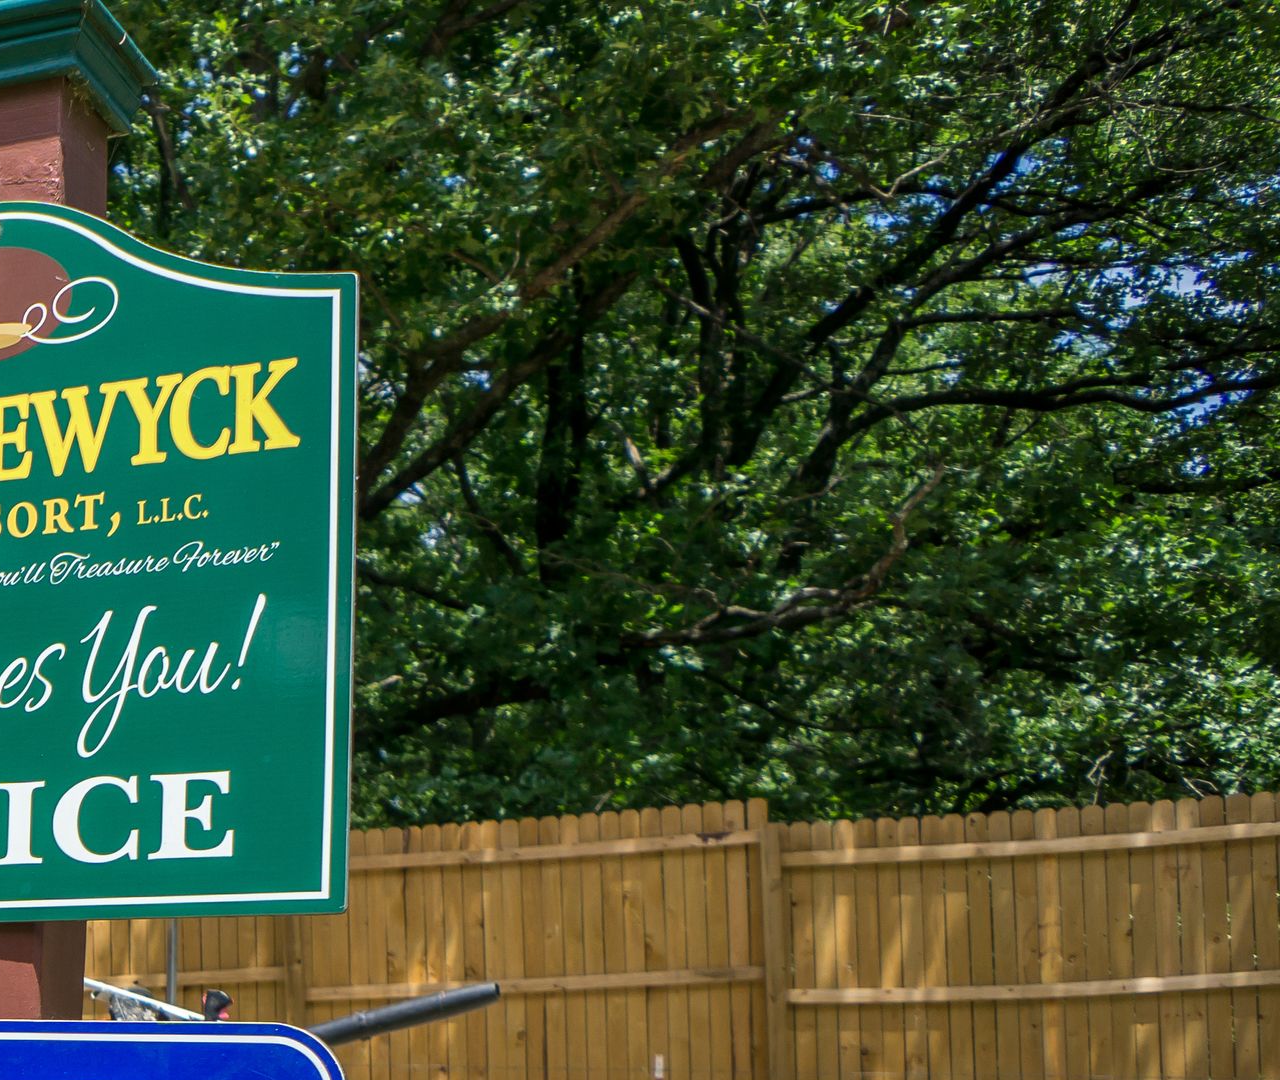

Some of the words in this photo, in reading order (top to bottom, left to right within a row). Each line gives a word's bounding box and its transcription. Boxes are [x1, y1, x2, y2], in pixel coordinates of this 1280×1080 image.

[136, 494, 209, 525] L.L.C.
[49, 551, 170, 585] Treasure
[75, 593, 268, 758] You!
